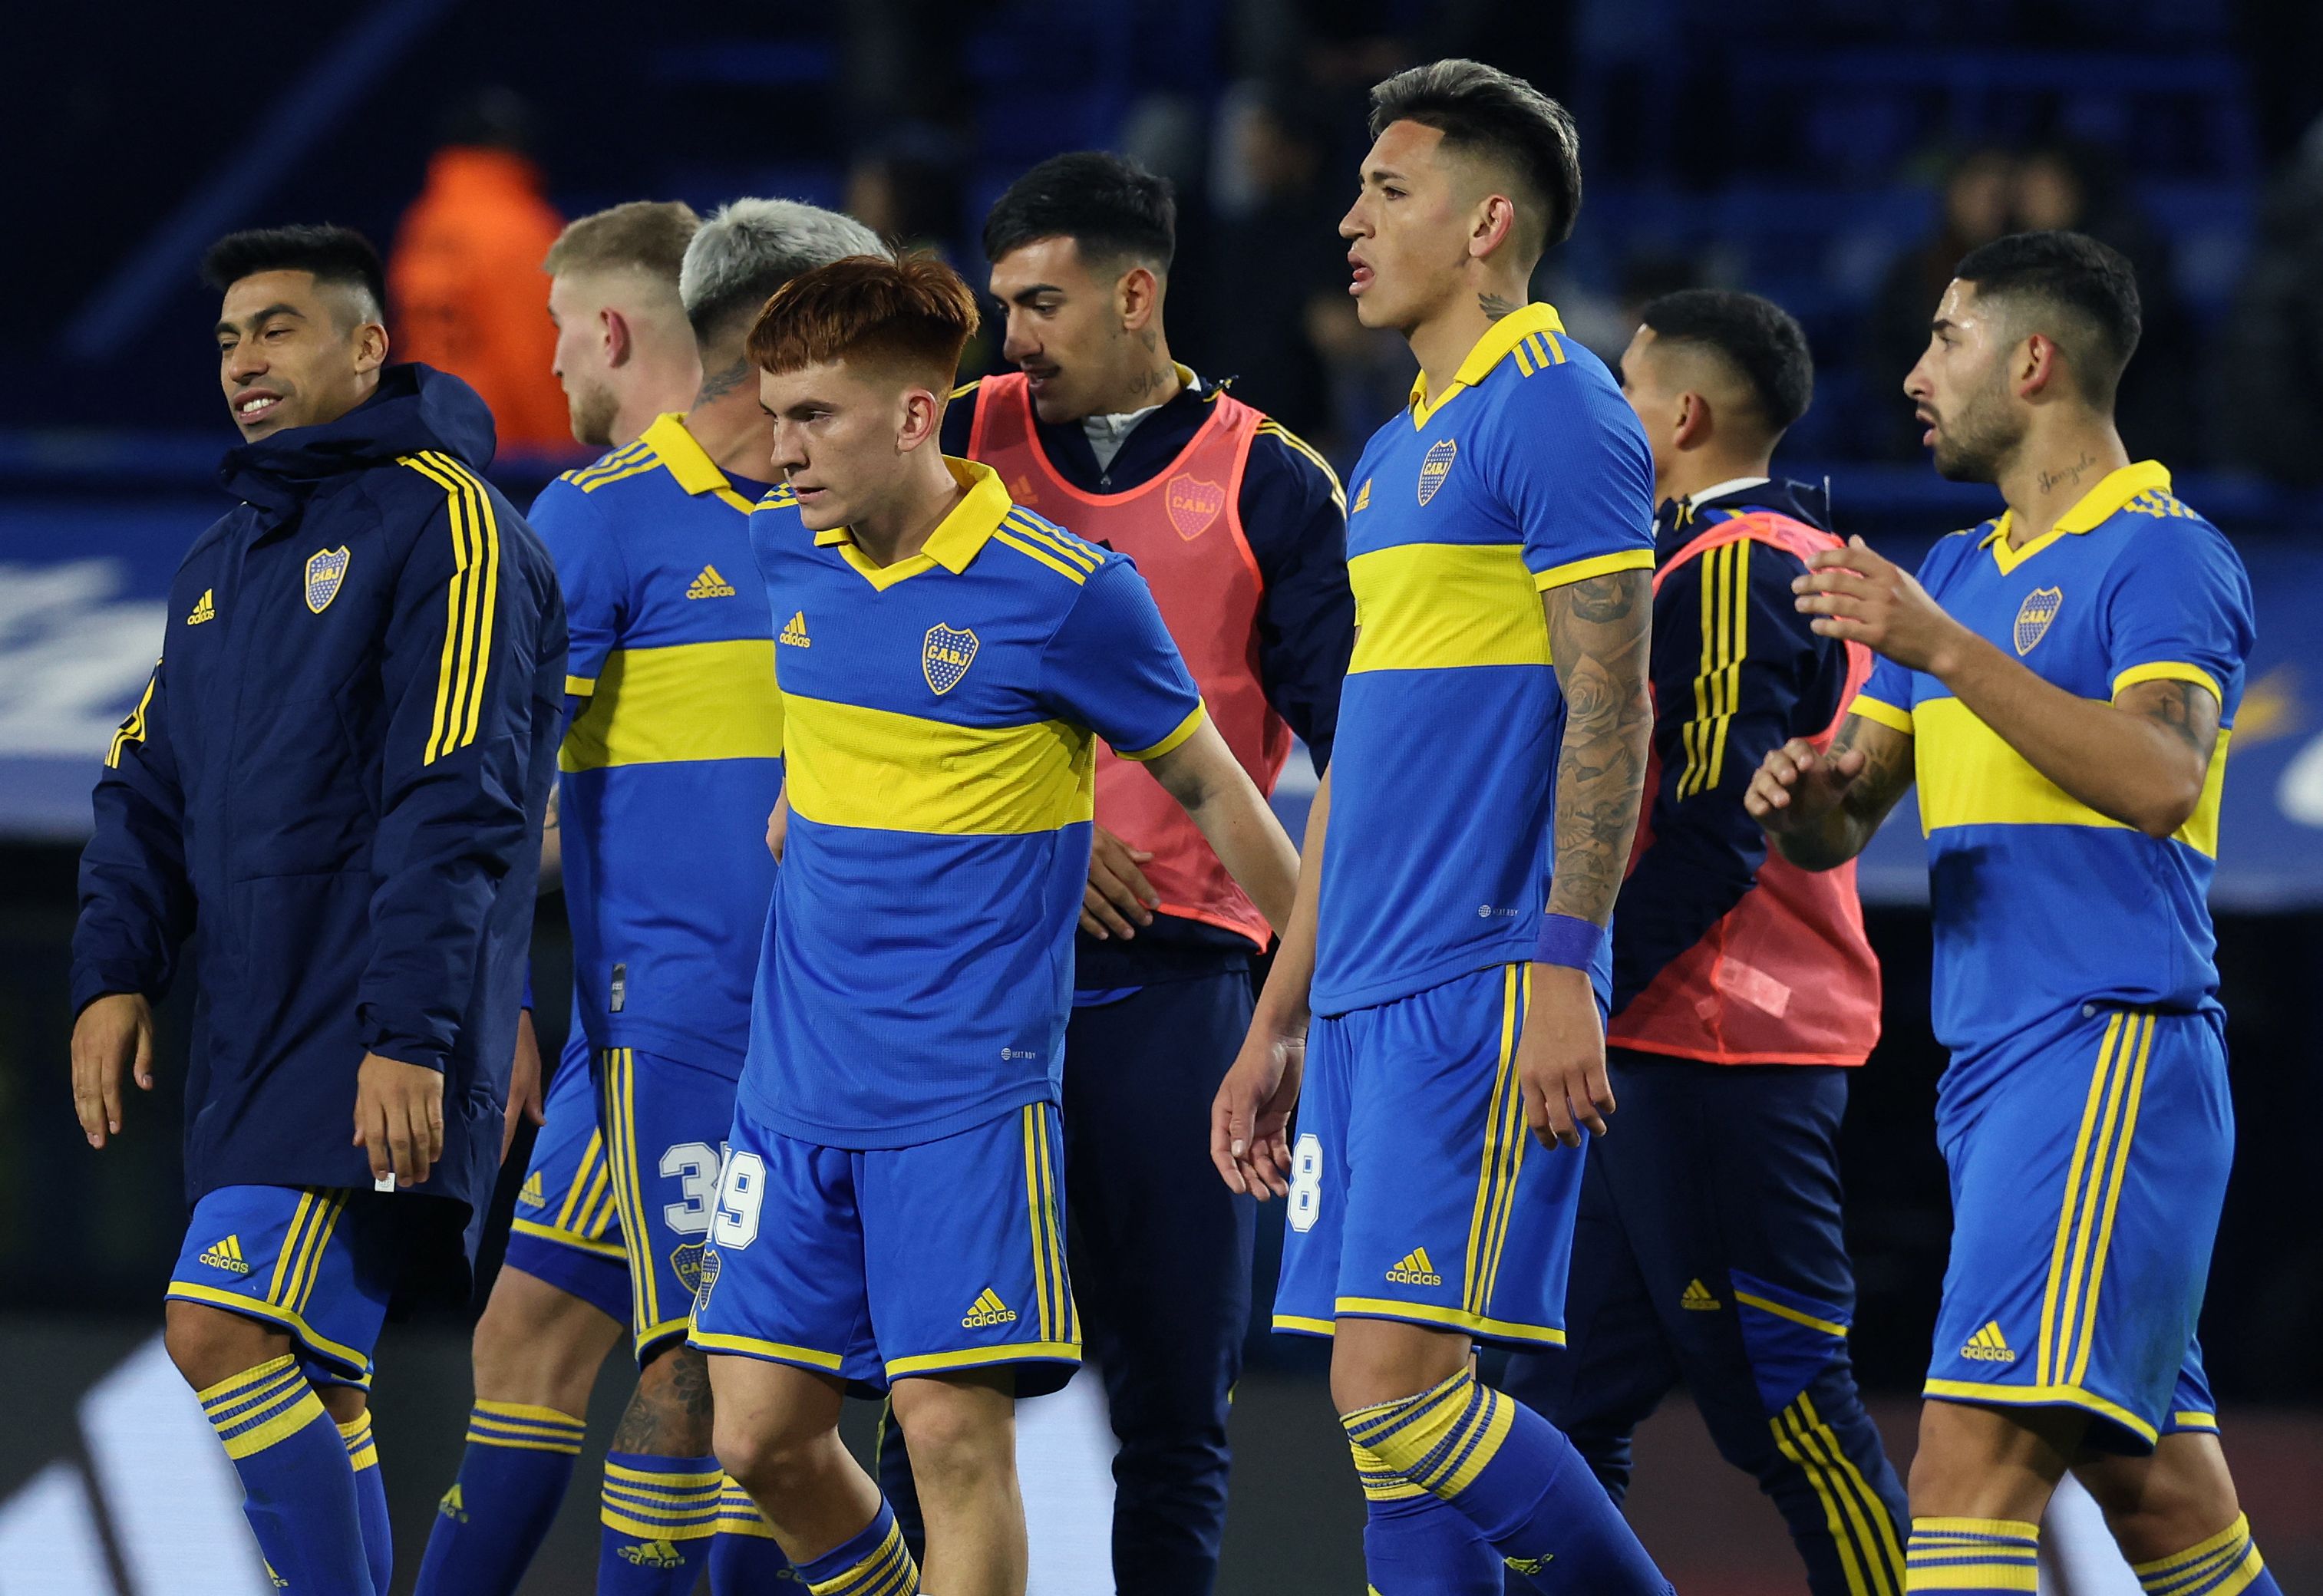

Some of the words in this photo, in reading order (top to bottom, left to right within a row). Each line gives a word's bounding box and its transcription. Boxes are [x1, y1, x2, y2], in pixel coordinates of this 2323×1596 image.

[1424, 462, 1450, 475] CABJ
[1173, 496, 1216, 513] CABJ
[685, 586, 736, 599] adidas
[187, 609, 216, 625] adidas
[779, 632, 811, 648] adidas
[927, 645, 969, 666] CABJ
[1287, 1133, 1323, 1232] 8
[199, 1253, 249, 1274] adidas
[1385, 1270, 1442, 1286] adidas
[962, 1310, 1018, 1328] adidas
[1960, 1346, 2016, 1363] adidas
